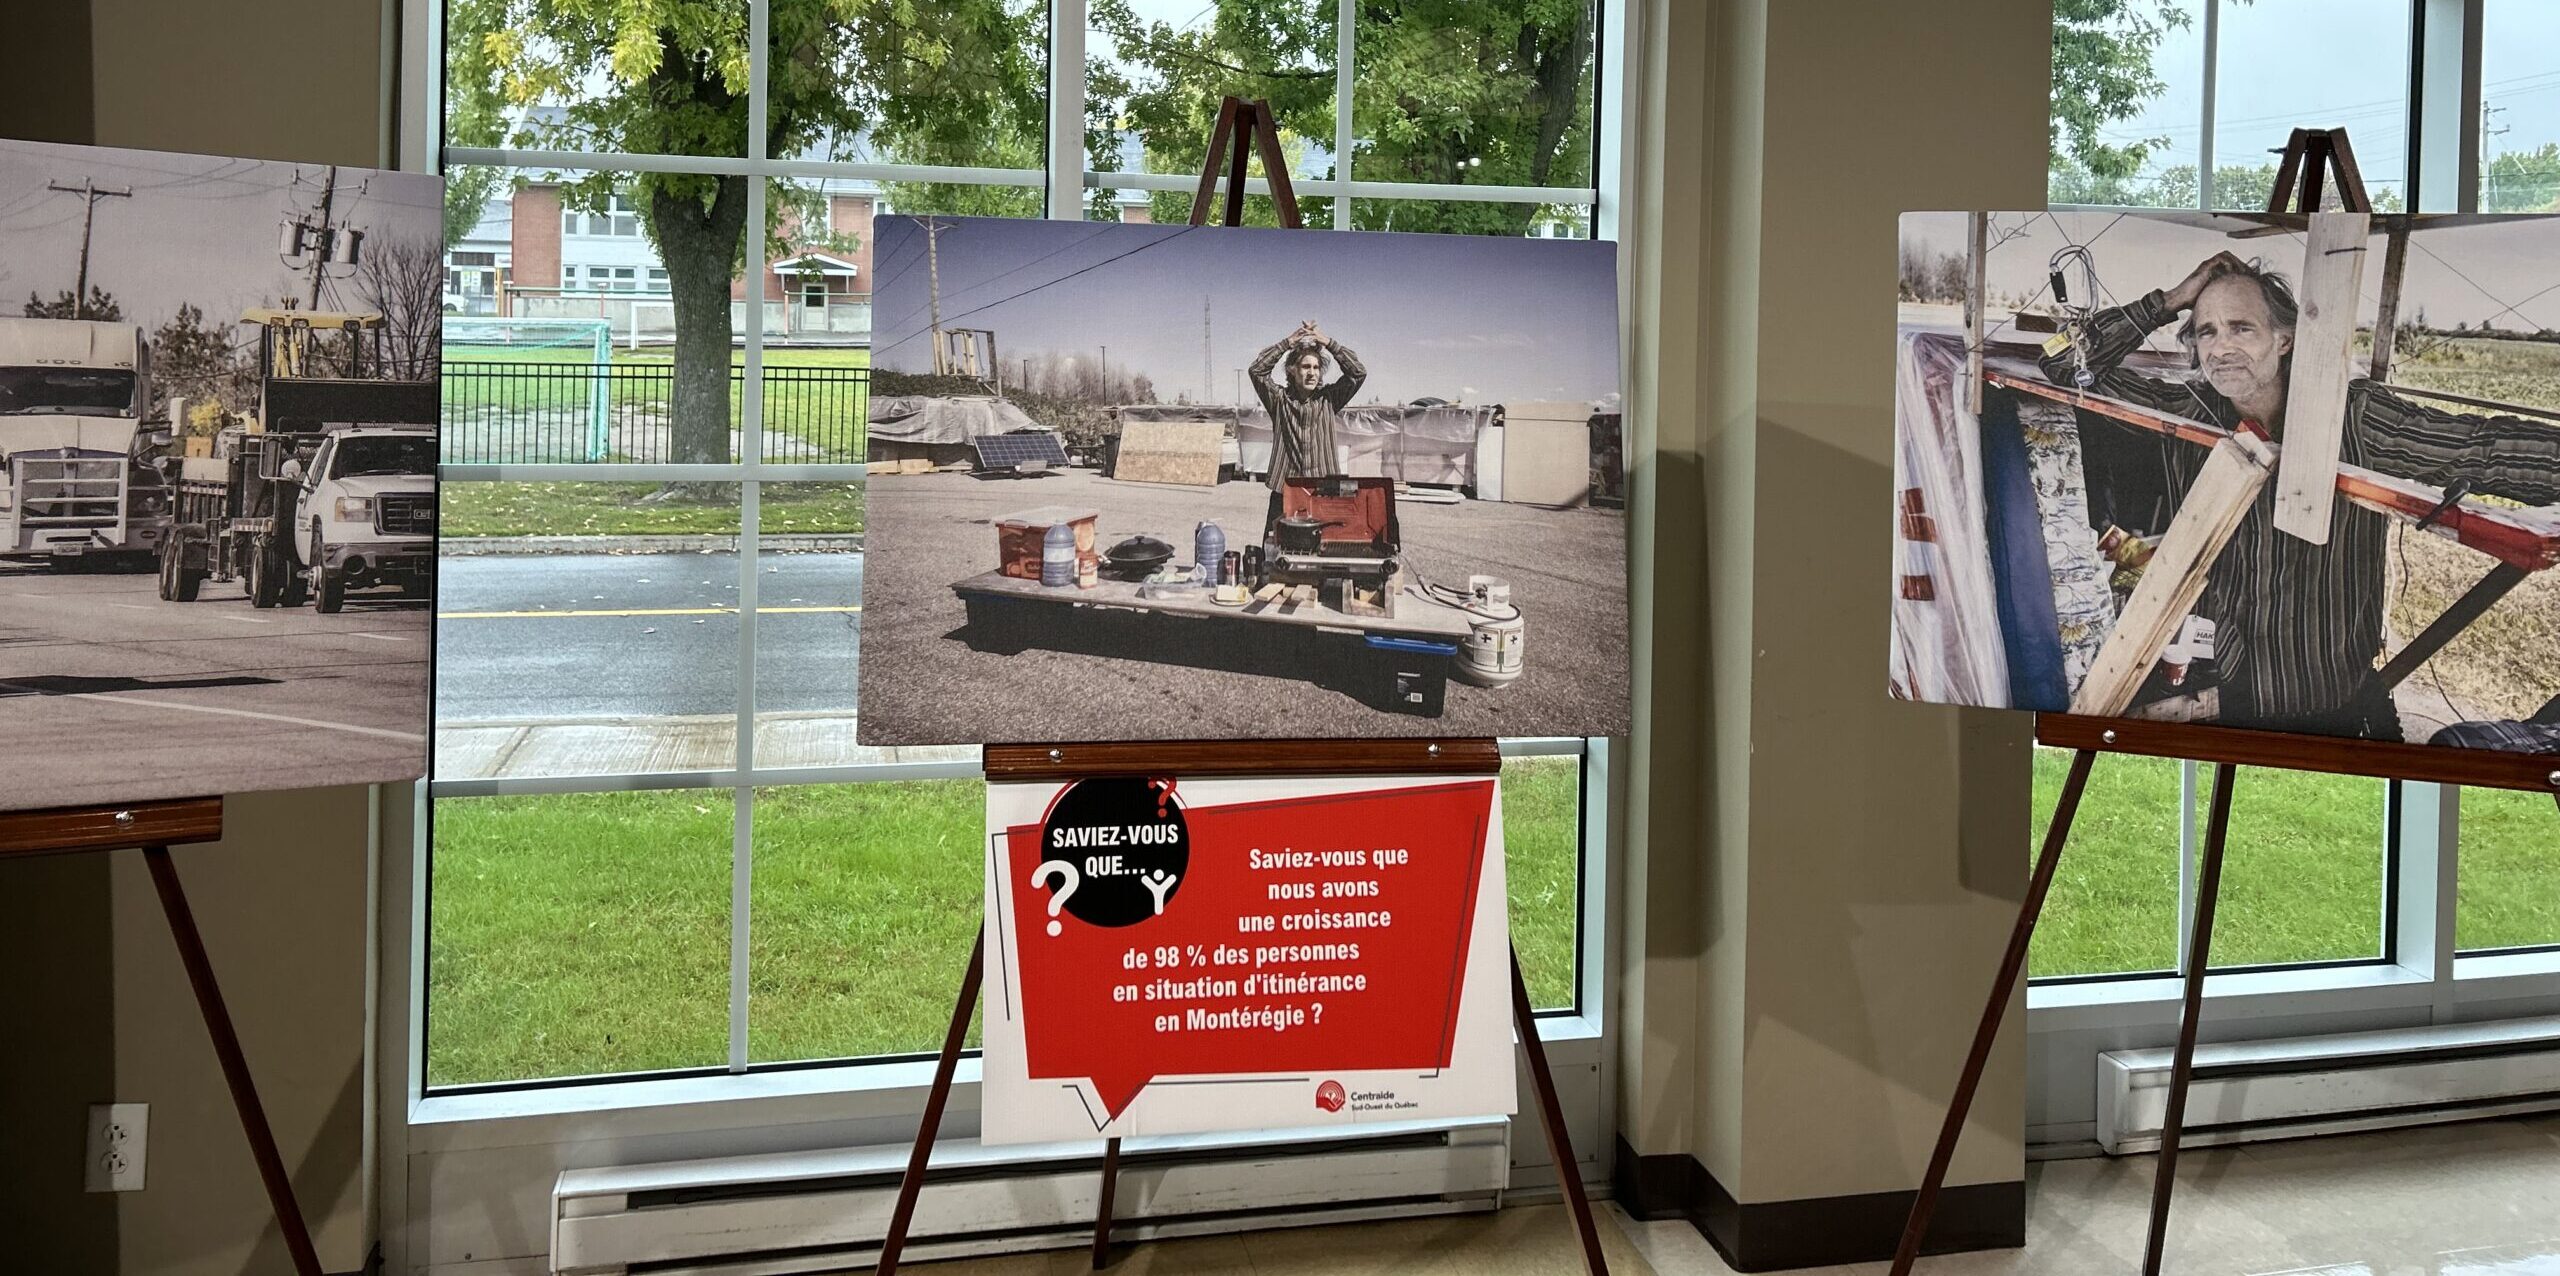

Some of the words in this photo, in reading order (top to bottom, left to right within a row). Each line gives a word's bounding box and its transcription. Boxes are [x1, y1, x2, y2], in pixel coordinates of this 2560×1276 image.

[1052, 823, 1179, 848] SAVIEZ-VOUS
[1085, 855, 1146, 879] QUE...
[1249, 847, 1367, 870] Saviez-vous
[1372, 848, 1409, 870] que
[1268, 882, 1316, 900] nous
[1321, 880, 1380, 898] avons
[1238, 915, 1276, 933] une
[1281, 908, 1392, 931] croissance
[1122, 947, 1148, 970] de
[1154, 945, 1180, 968] 98
[1186, 944, 1207, 967] %
[1213, 943, 1249, 966] des
[1255, 942, 1361, 969] personnes
[1113, 984, 1138, 1002] en
[1144, 976, 1237, 1001] situation
[1243, 971, 1367, 997] d'itinérance
[1154, 1014, 1180, 1033] en
[1186, 1004, 1306, 1032] Montérégie
[1310, 1001, 1324, 1025] ?
[1350, 1091, 1395, 1102] Centraide
